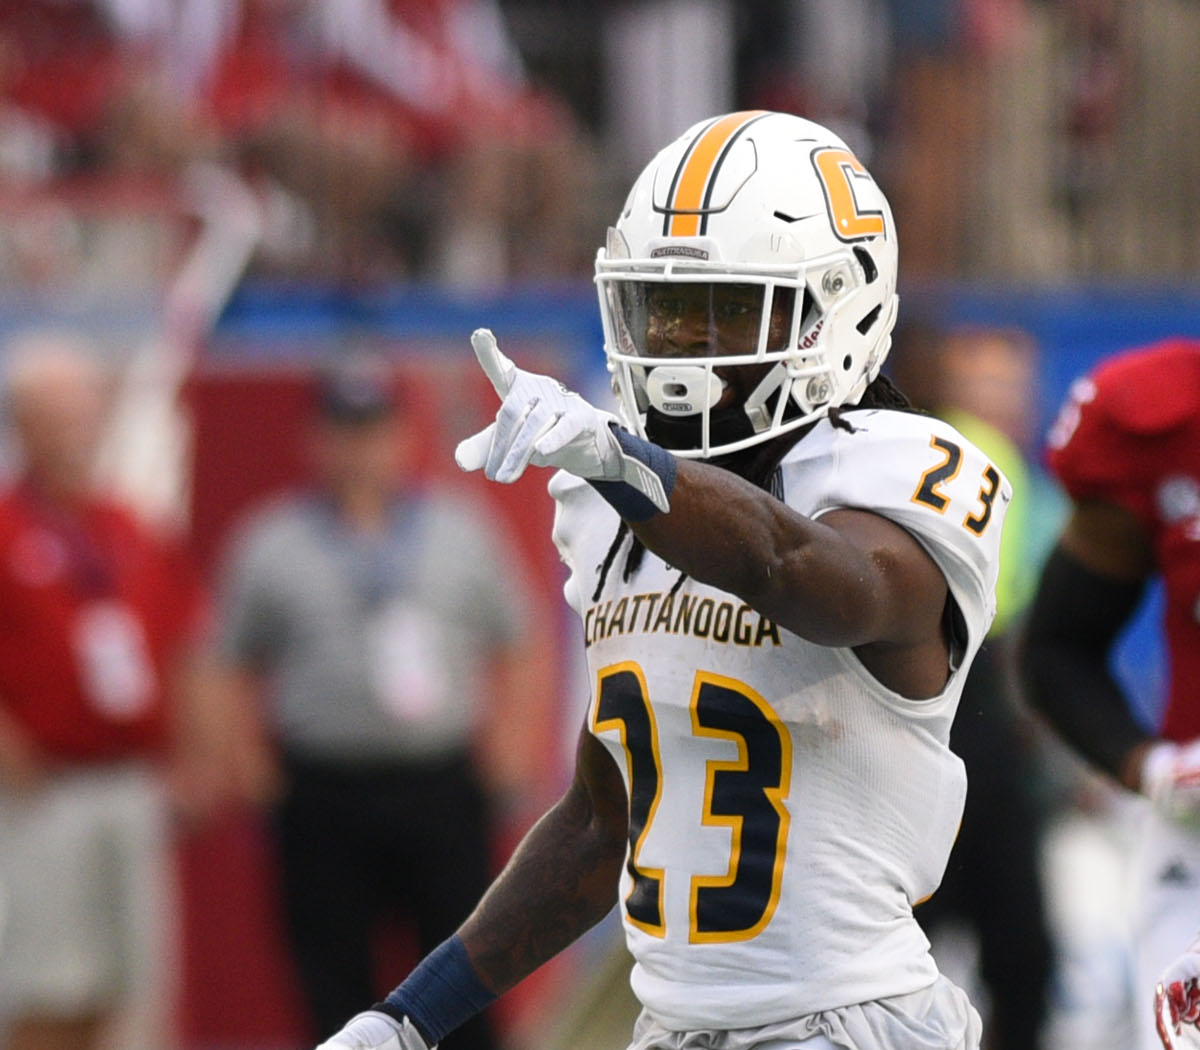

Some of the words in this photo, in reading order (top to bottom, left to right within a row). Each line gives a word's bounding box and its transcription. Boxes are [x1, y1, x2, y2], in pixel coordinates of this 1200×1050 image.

[810, 146, 886, 243] C
[910, 433, 1003, 538] 23
[584, 592, 783, 648] CHATTANOOGA
[592, 659, 793, 945] 23
